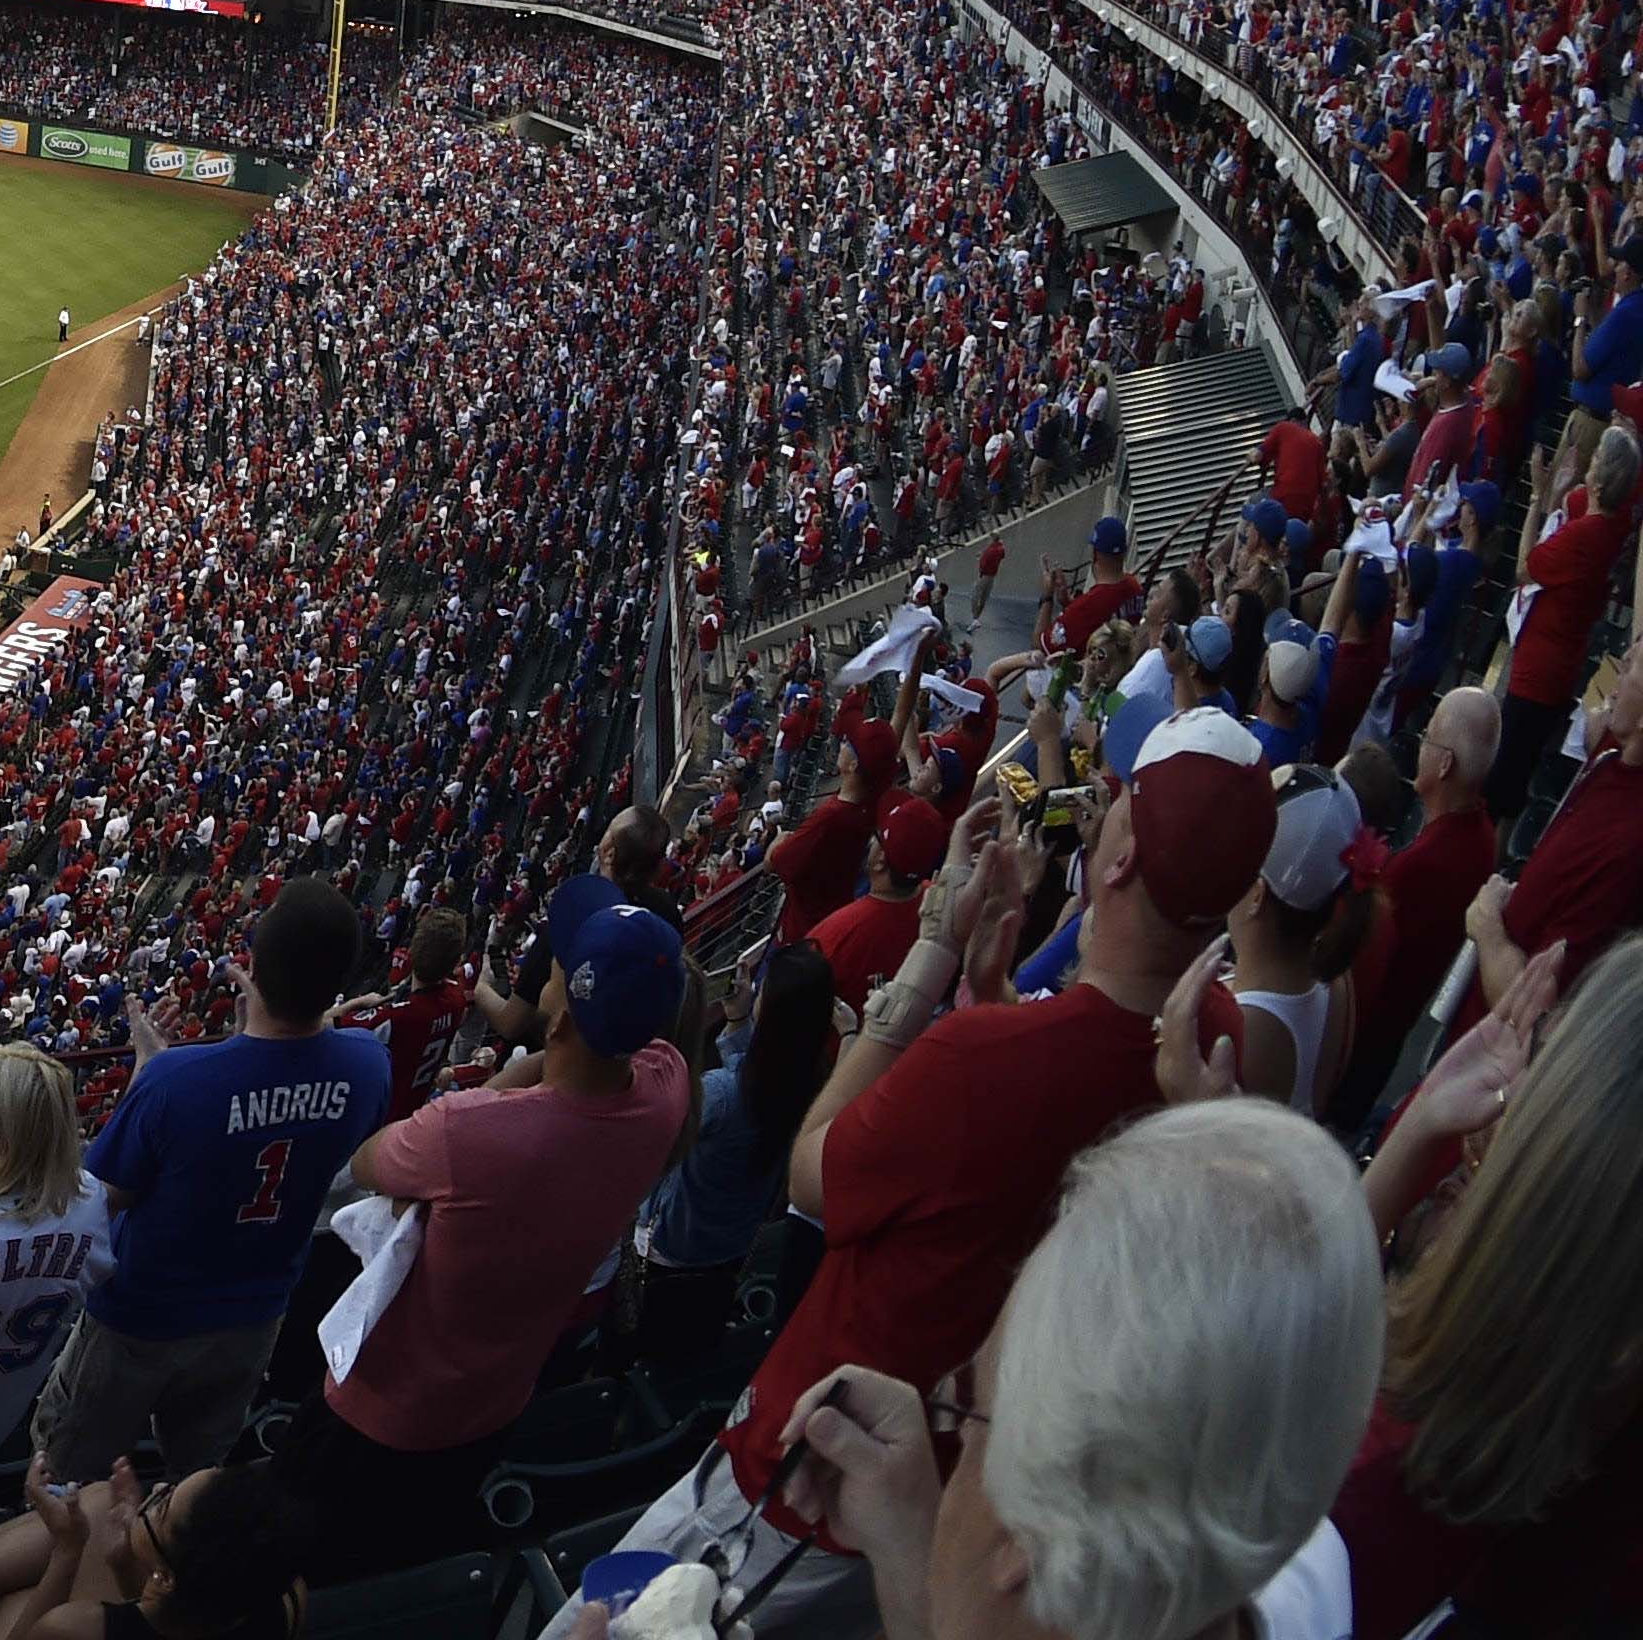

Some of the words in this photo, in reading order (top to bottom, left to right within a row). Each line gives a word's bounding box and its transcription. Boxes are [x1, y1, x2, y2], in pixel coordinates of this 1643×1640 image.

[48, 136, 82, 150] Scotts
[89, 145, 107, 155] used
[149, 153, 183, 169] Gulf
[196, 160, 230, 176] Gulf
[226, 1081, 351, 1136] ANDRUS
[236, 1139, 294, 1223] 1
